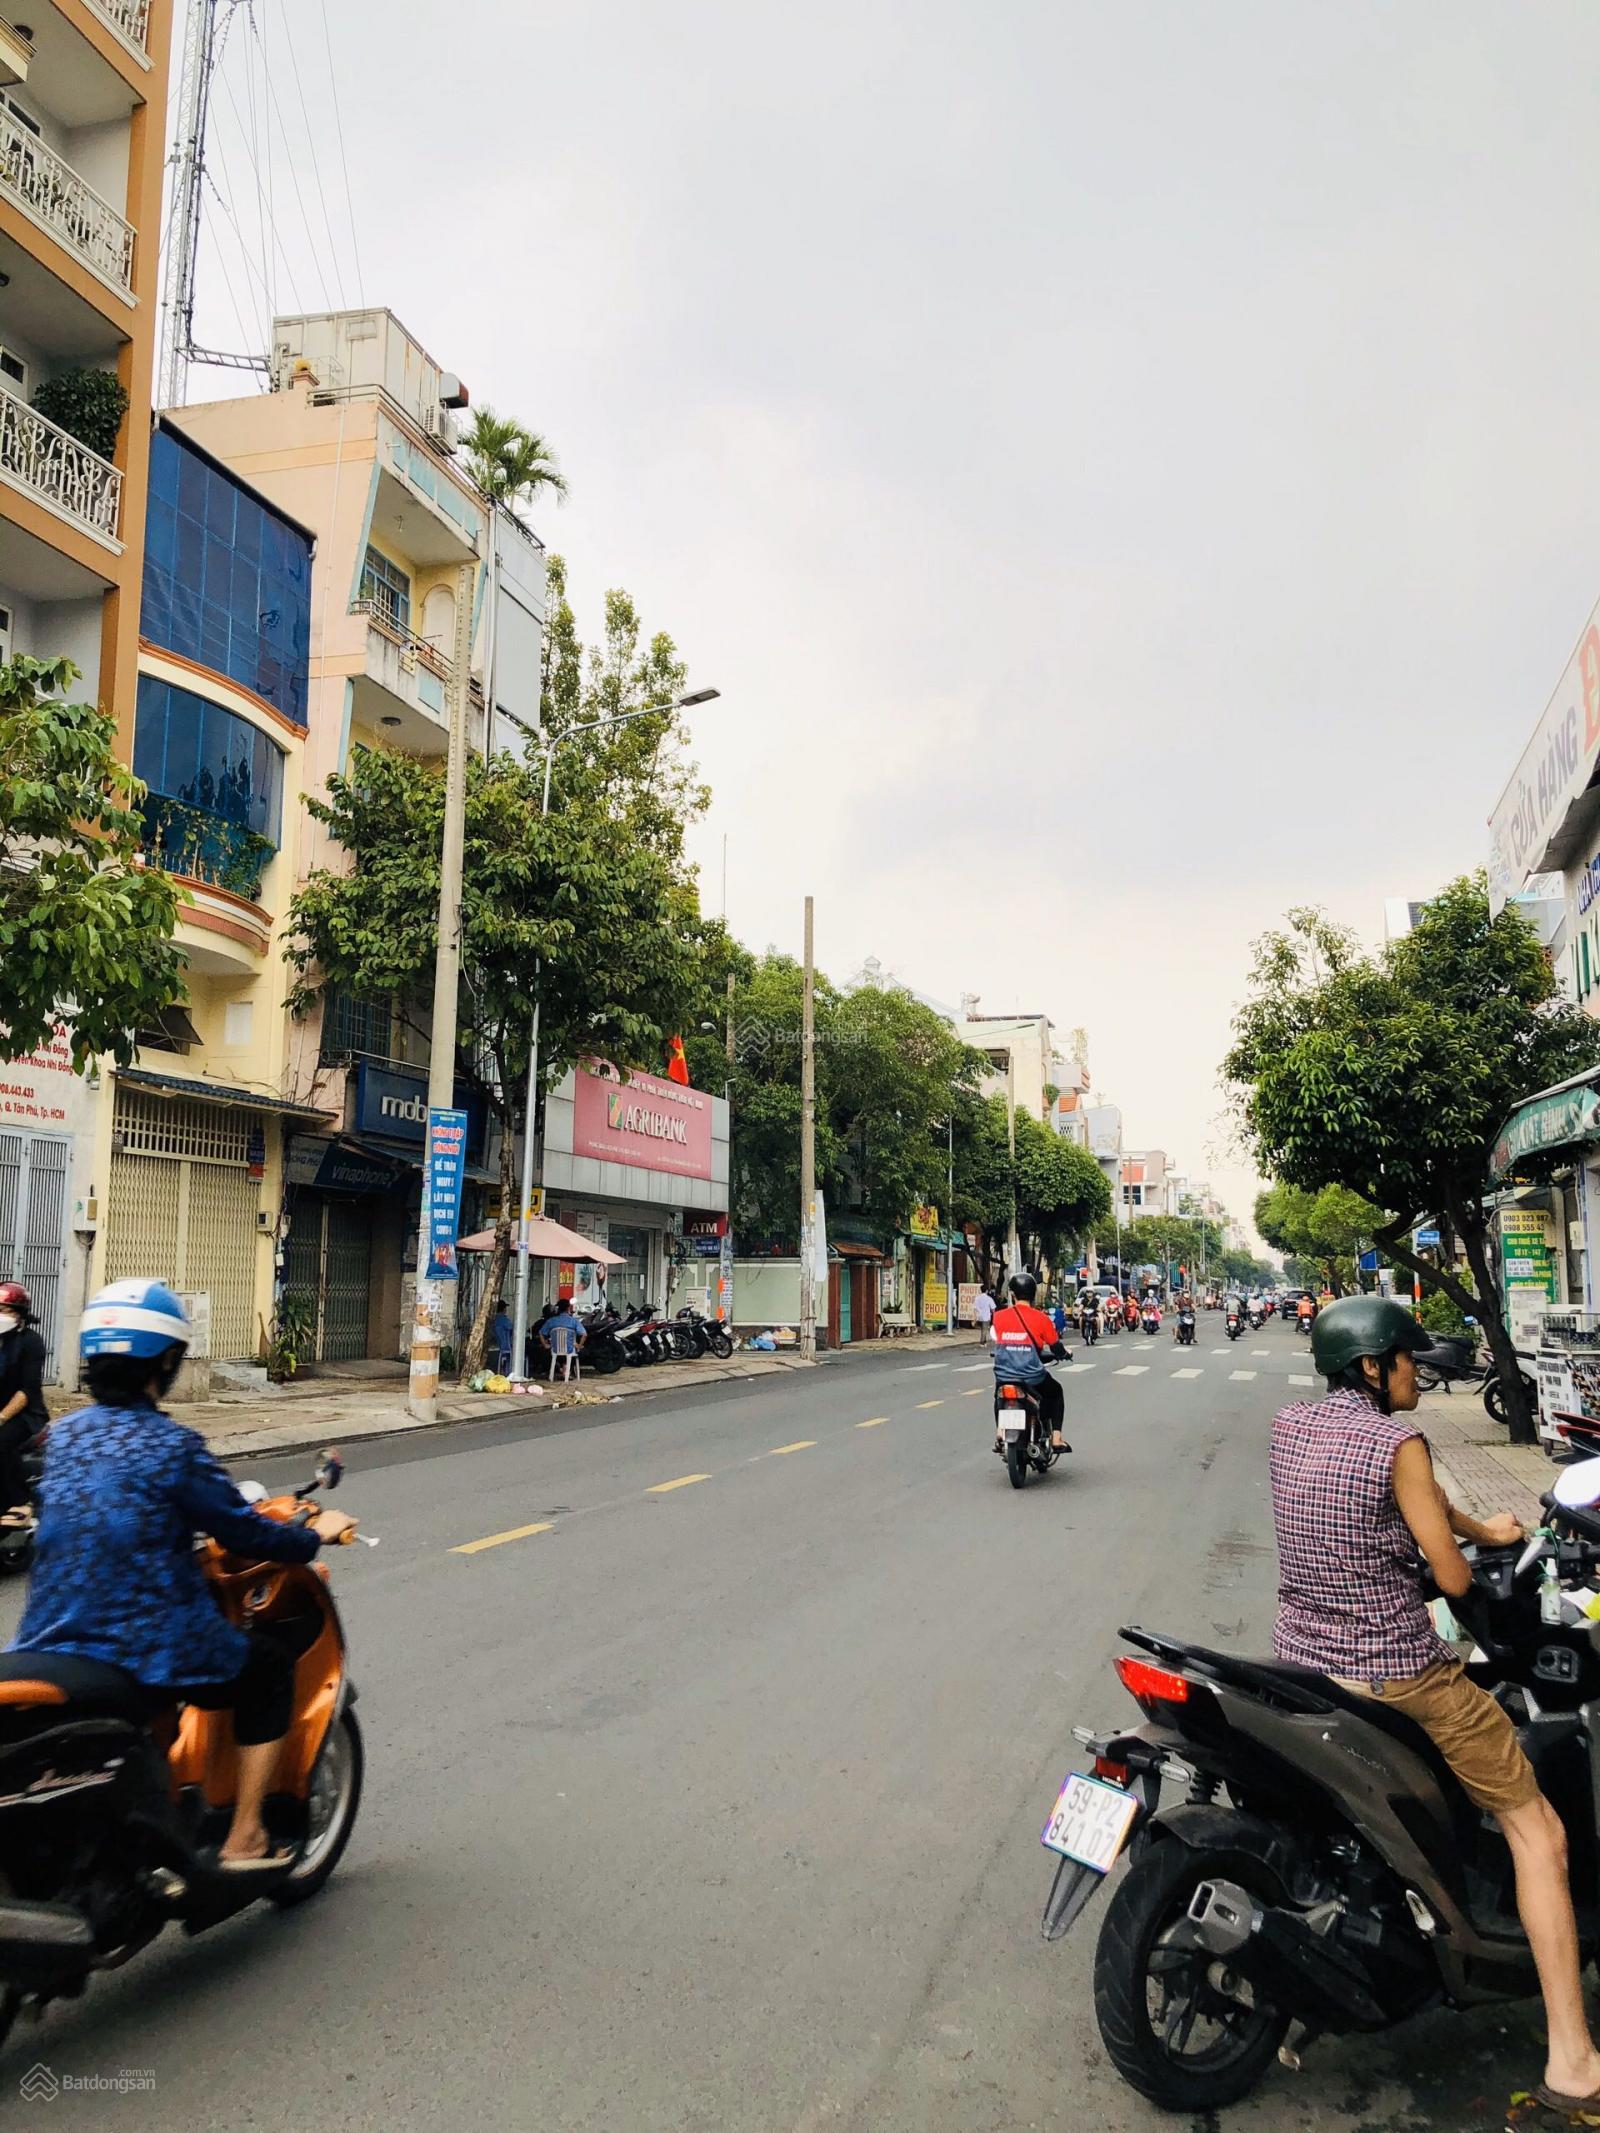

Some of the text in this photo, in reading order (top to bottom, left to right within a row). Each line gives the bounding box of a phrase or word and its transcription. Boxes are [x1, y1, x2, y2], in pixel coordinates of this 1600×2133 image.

[1538, 706, 1577, 827] HÀNG
[50, 1108, 65, 1120] HCM
[381, 1094, 428, 1123] mob
[624, 1104, 688, 1145] AGRIBANK
[332, 1162, 391, 1185] vinaphone
[690, 1222, 718, 1234] ATM
